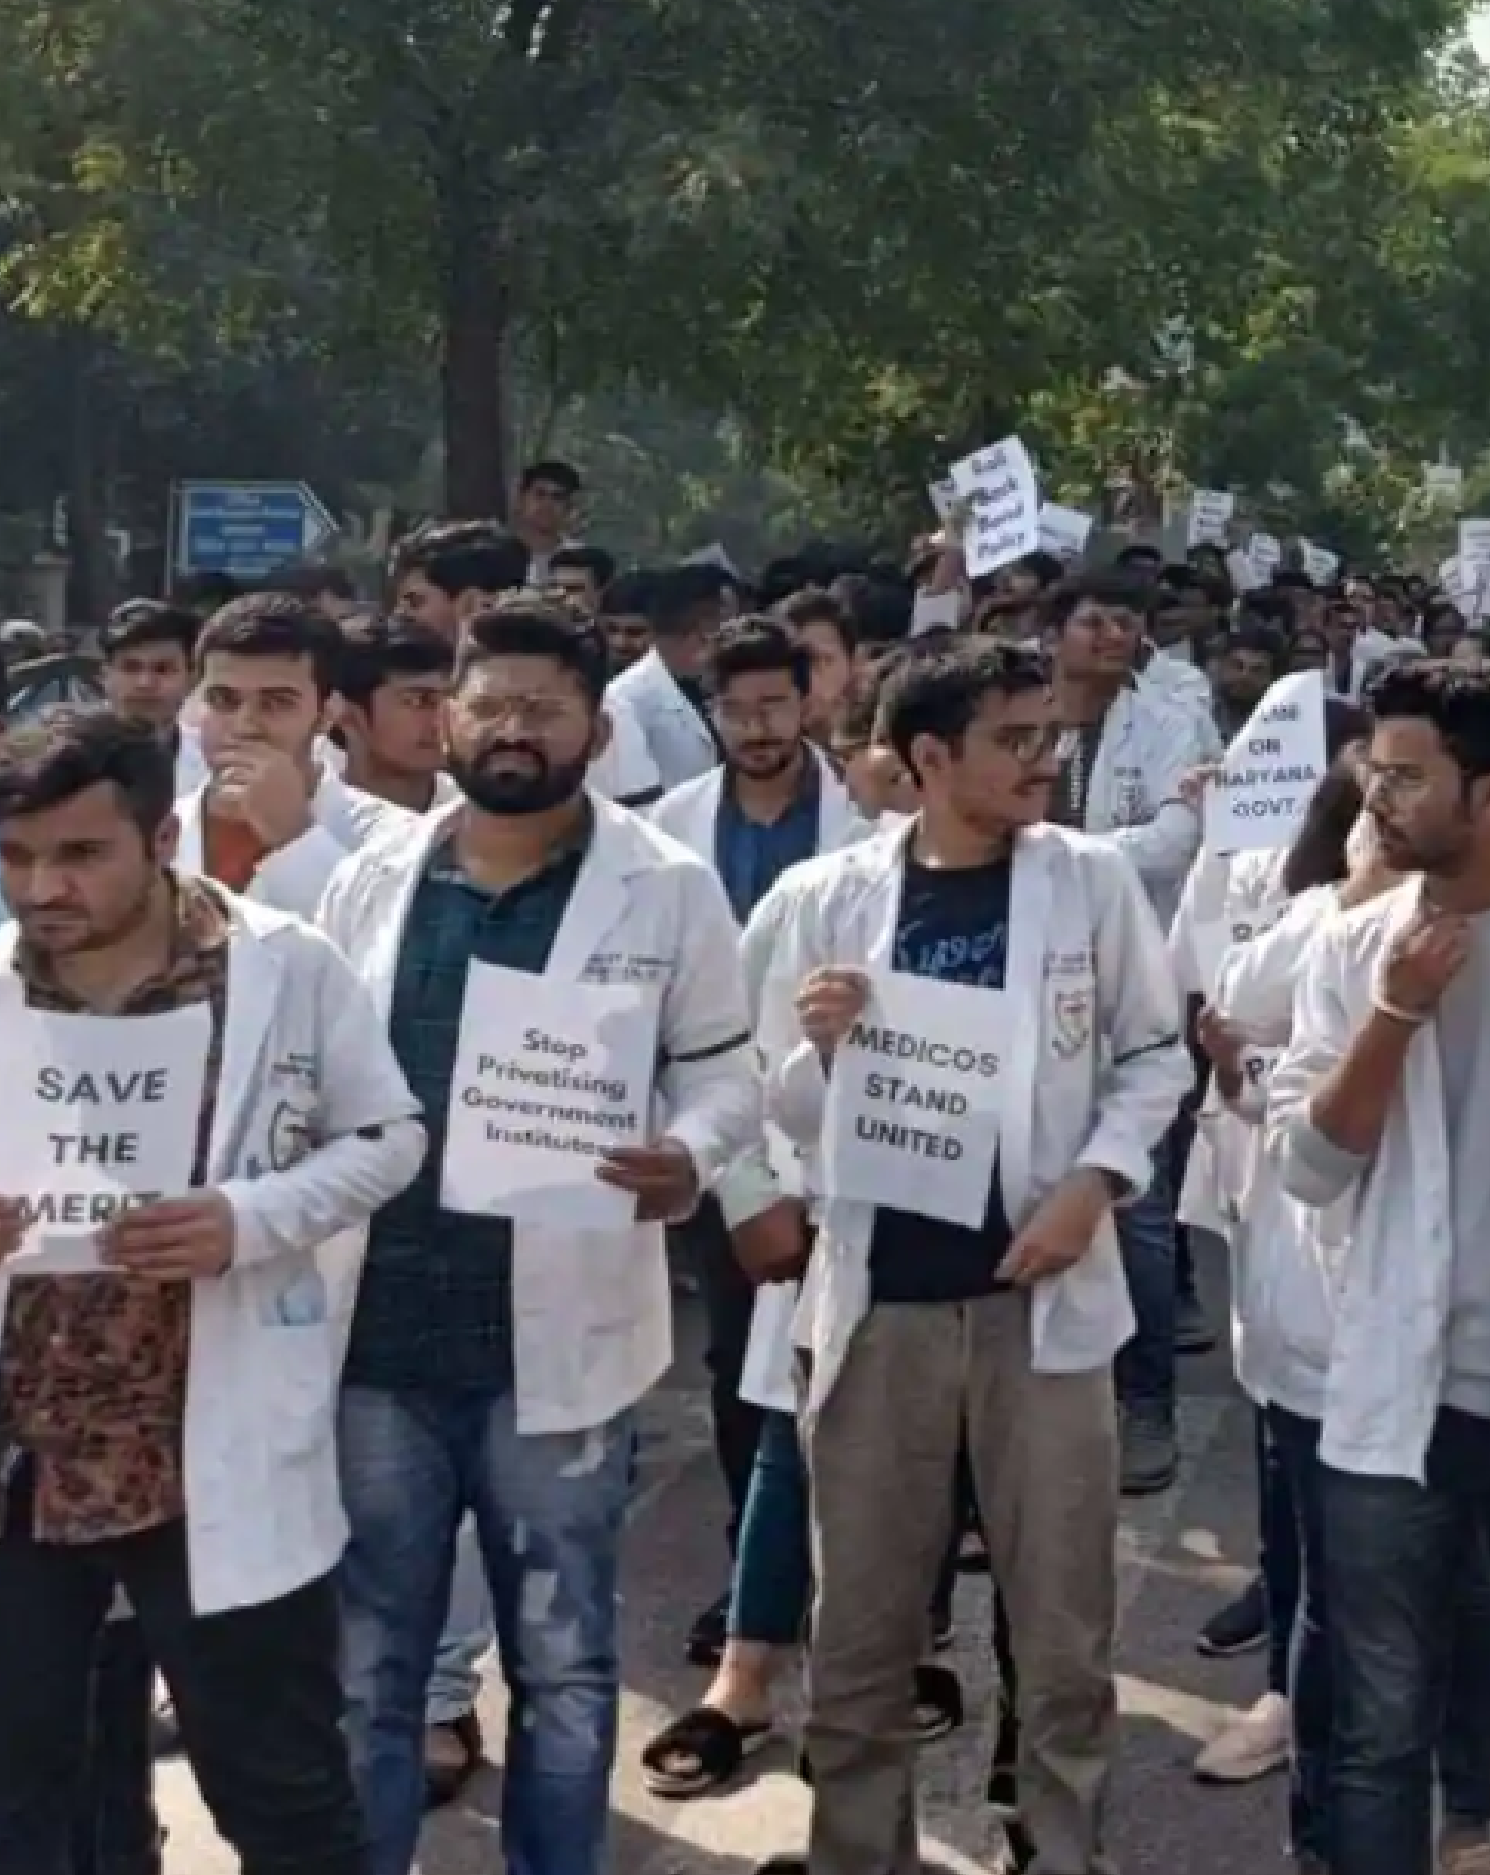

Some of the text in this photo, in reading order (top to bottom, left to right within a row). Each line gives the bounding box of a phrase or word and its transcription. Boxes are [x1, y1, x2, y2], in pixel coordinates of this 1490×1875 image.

[521, 1026, 589, 1065] Stop
[847, 1020, 999, 1078] MEDICOS
[34, 1066, 168, 1105] SAVE
[476, 1052, 629, 1104] Privatising
[864, 1071, 968, 1116] STAND
[459, 1085, 638, 1132] Government
[46, 1131, 140, 1167] THE
[855, 1114, 963, 1162] UNITED
